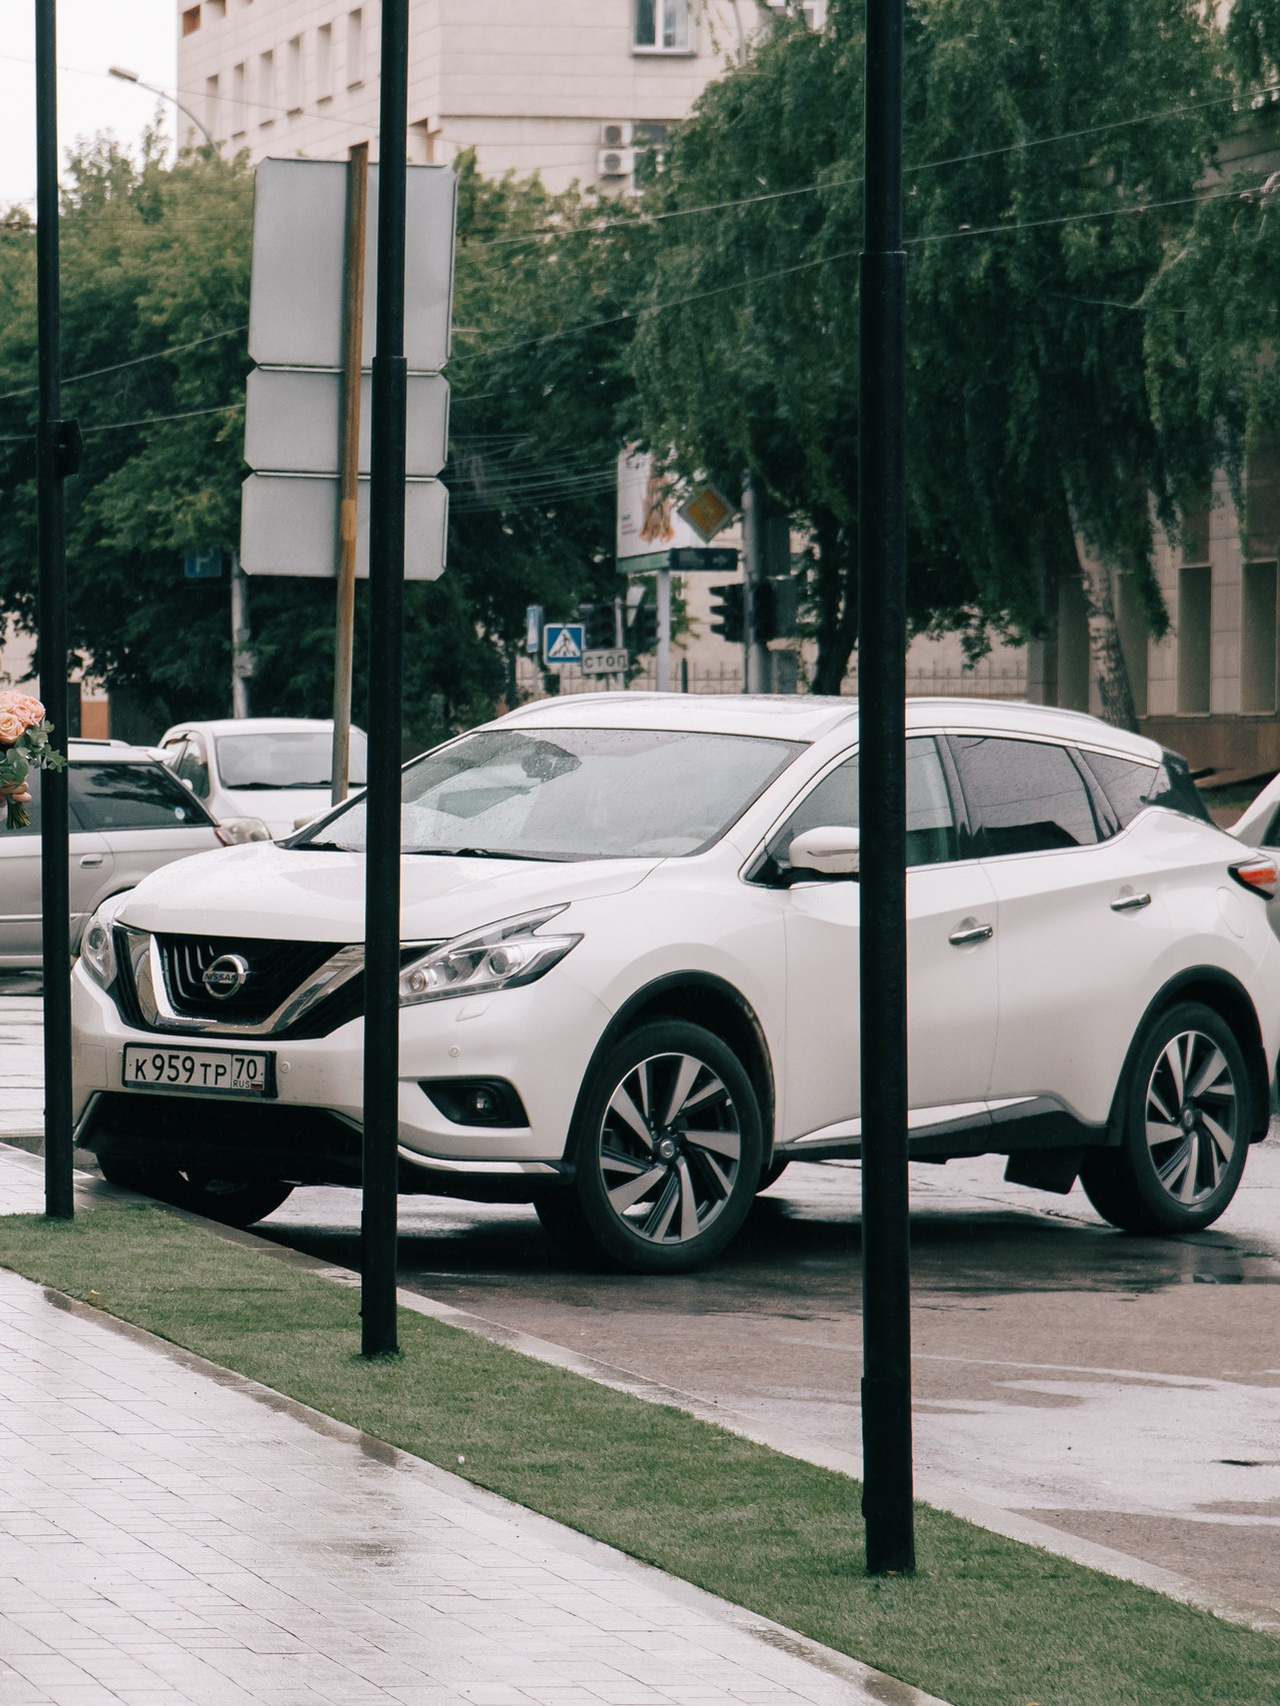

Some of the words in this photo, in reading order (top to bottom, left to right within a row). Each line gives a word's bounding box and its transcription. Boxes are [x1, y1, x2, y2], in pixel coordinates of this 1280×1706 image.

[584, 655, 627, 669] СТОП
[204, 972, 238, 982] NISSAN
[234, 1058, 257, 1080] 70
[233, 1080, 250, 1088] RUS
